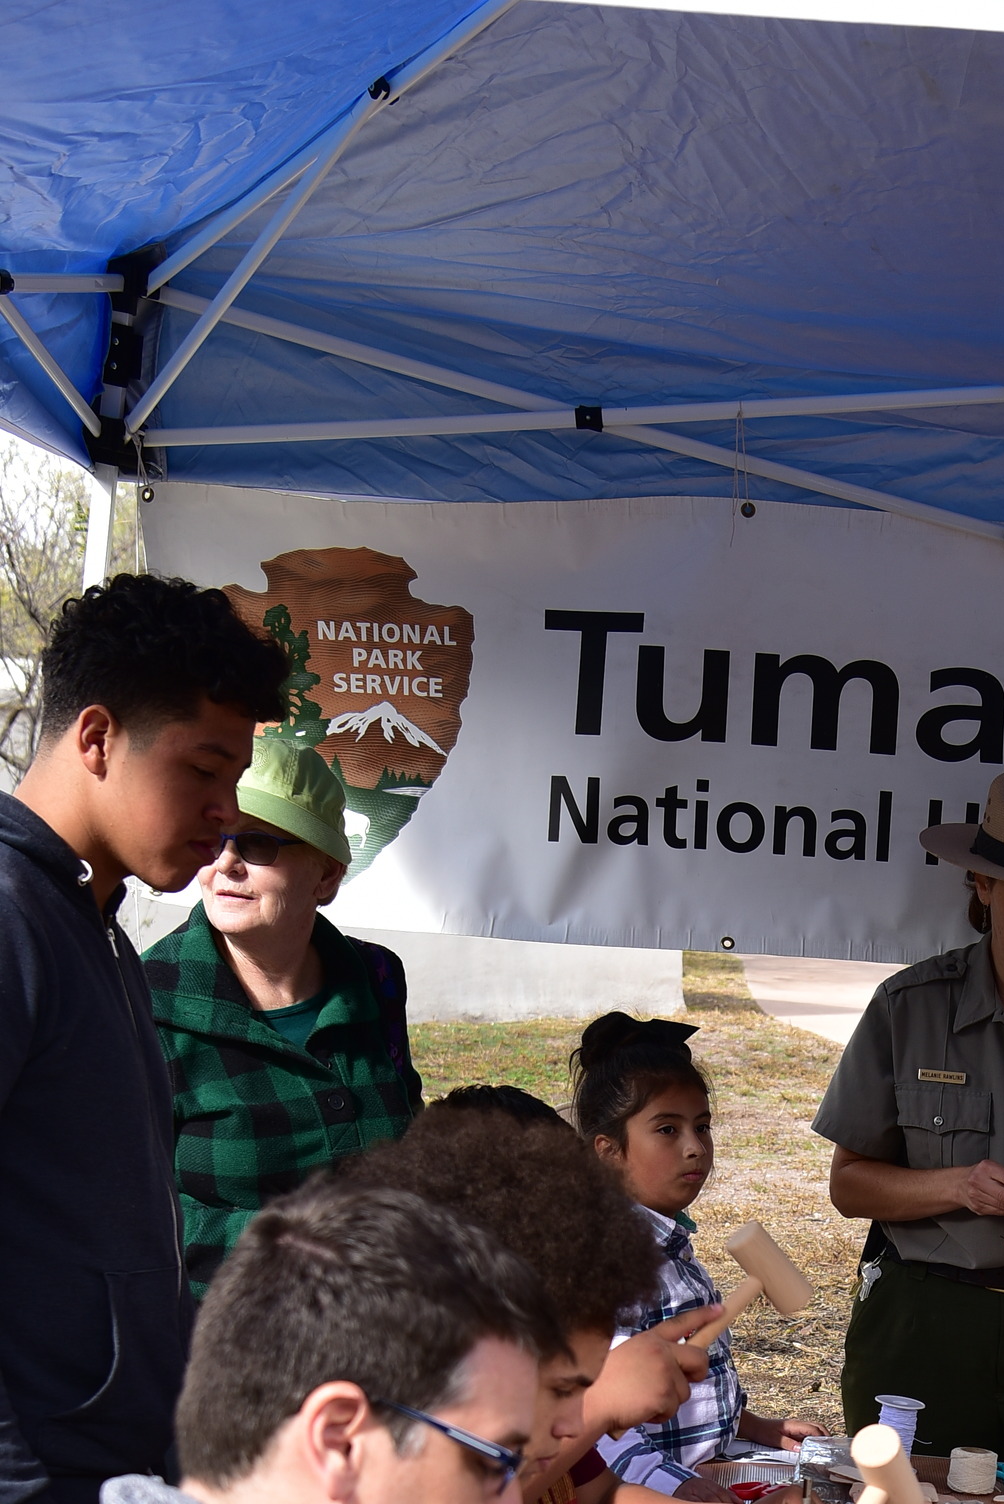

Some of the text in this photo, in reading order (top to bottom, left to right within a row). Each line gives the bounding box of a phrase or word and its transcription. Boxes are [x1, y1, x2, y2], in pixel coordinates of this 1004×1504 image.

[316, 619, 457, 647] NATIONAL
[351, 648, 424, 671] PARK
[332, 672, 444, 699] SERVICE
[548, 775, 893, 862] National
